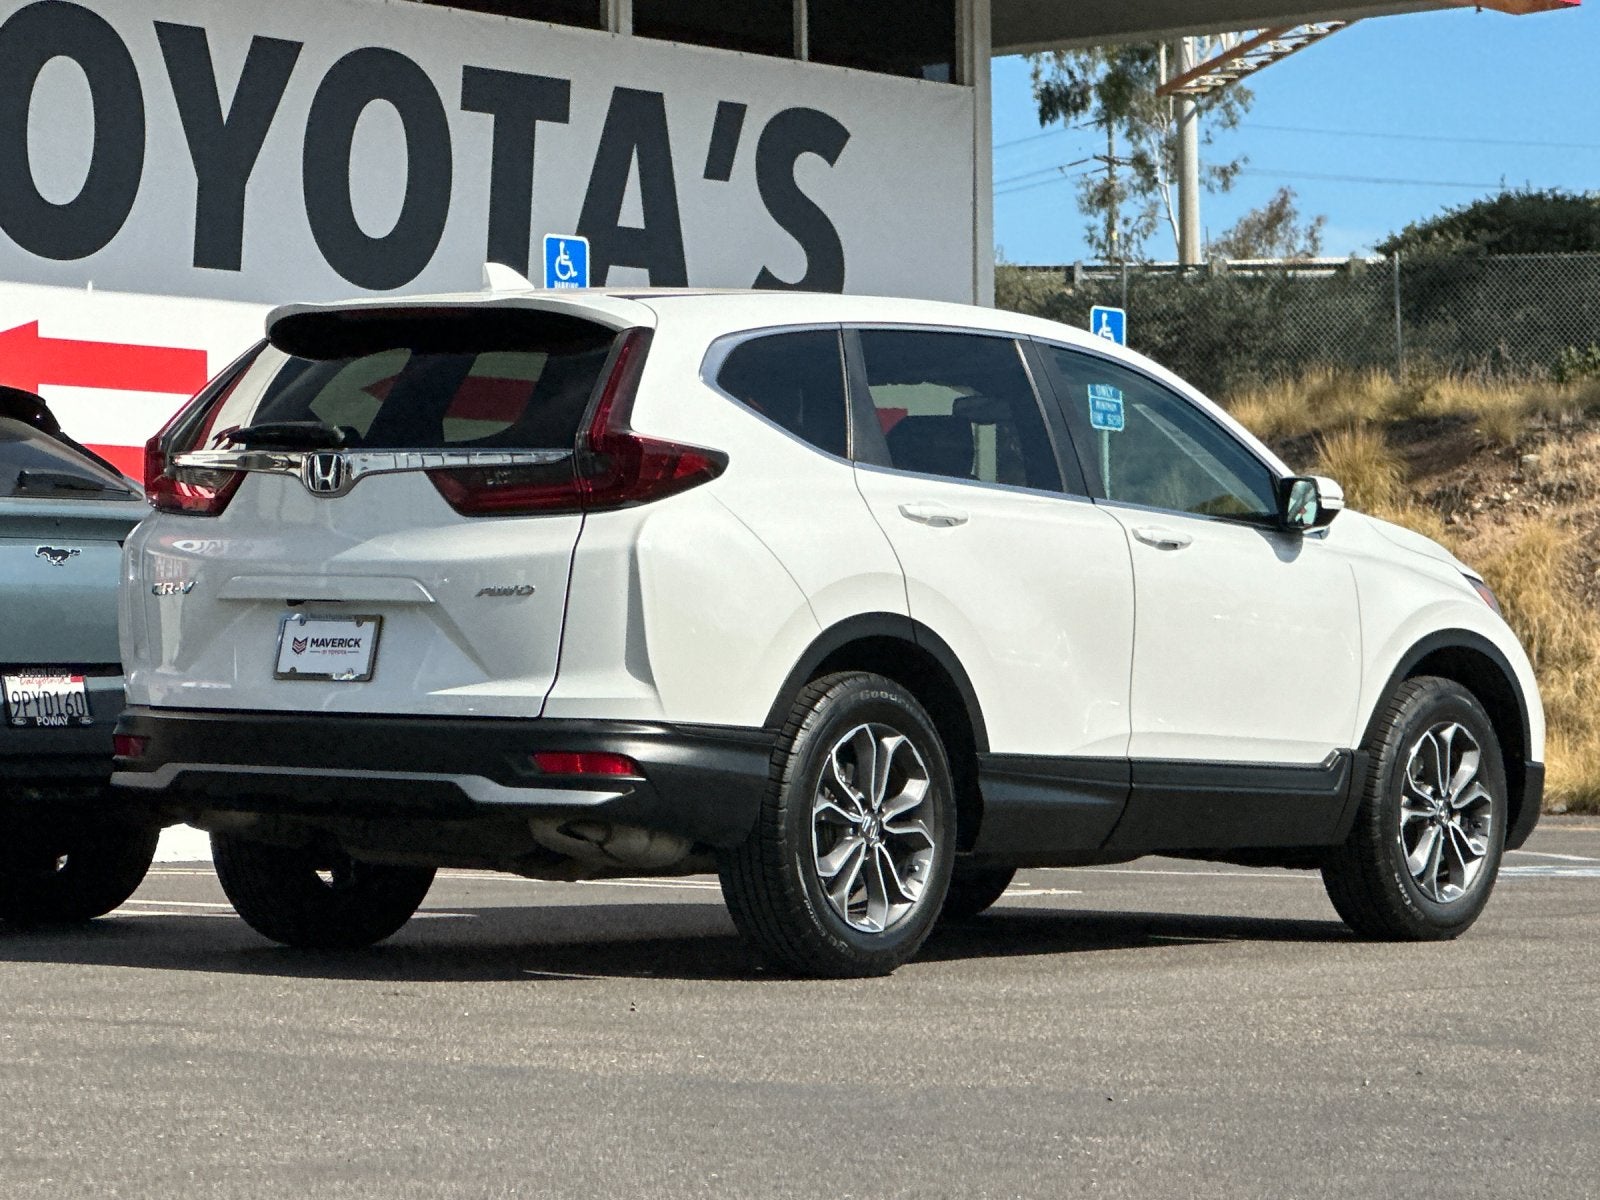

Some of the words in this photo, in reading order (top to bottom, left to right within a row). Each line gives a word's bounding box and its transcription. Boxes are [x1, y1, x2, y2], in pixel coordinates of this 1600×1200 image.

[0, 0, 851, 294] OYOTA'S
[152, 581, 198, 596] CR-V
[310, 638, 362, 648] MAVERICK
[12, 691, 85, 717] 9PYD160
[36, 716, 68, 726] POWAY
